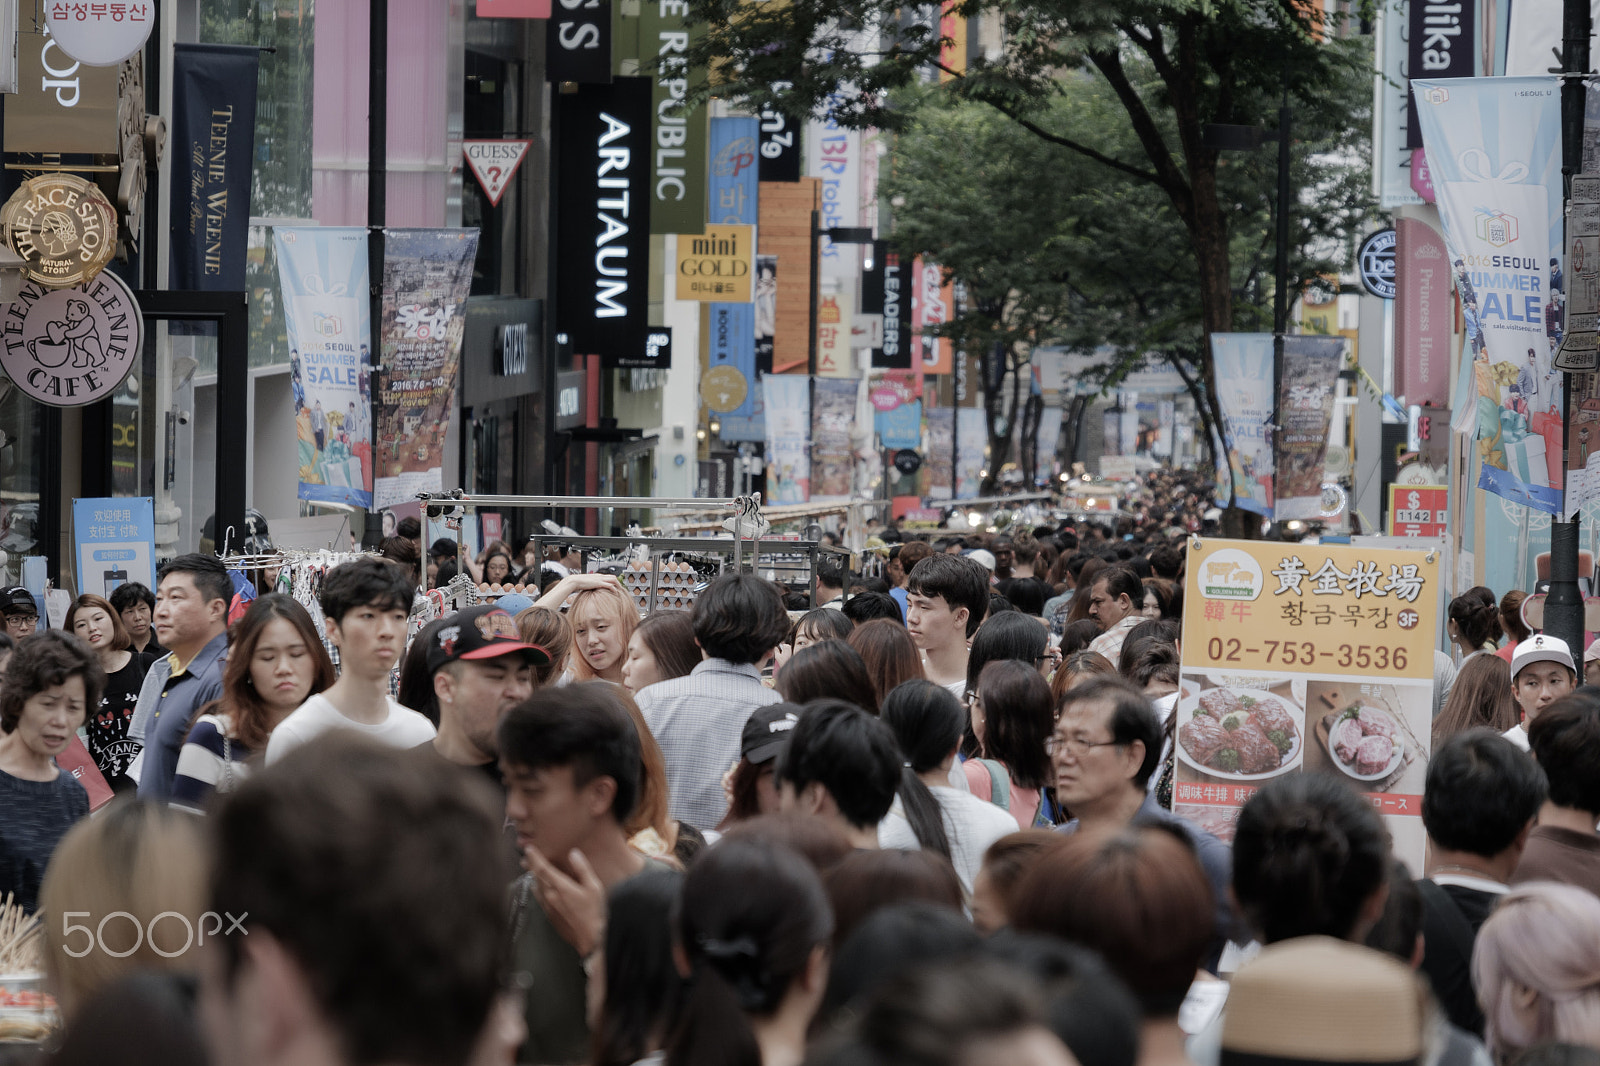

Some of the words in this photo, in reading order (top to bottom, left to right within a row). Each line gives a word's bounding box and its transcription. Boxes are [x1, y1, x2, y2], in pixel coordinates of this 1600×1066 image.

[52, 3, 147, 22] 삼성부동산
[1422, 0, 1462, 71] lika
[656, 32, 689, 201] REPUBLIC
[208, 105, 233, 183] TEENIE
[469, 145, 518, 159] GUESS
[595, 112, 631, 318] ARITAUM
[204, 188, 228, 275] WEENIE
[692, 233, 738, 256] mini
[39, 258, 74, 267] NATURAL
[42, 266, 70, 274] STORY
[680, 258, 748, 277] GOLD
[1492, 255, 1540, 271] SEOUL
[691, 281, 736, 294] 미니골드
[882, 266, 900, 357] LEADERS
[1419, 268, 1434, 332] Princess
[1475, 291, 1542, 323] ALE
[404, 320, 448, 341] 2016
[325, 342, 356, 352] SEOUL
[503, 322, 528, 376] GUESS
[818, 326, 839, 372] 맘스
[304, 352, 356, 366] SUMMER
[1419, 336, 1433, 384] House
[27, 367, 104, 397] CAFE
[306, 366, 357, 386] SALE
[94, 509, 131, 522] 欢迎使用
[1399, 512, 1430, 521] 1142
[88, 524, 117, 538] 支付宝
[1204, 600, 1252, 623] 韓牛
[1280, 601, 1393, 629] 황금목장
[1398, 611, 1419, 627] 3F
[1208, 637, 1408, 671] 02-753-3536
[1178, 784, 1228, 802] 调味牛排
